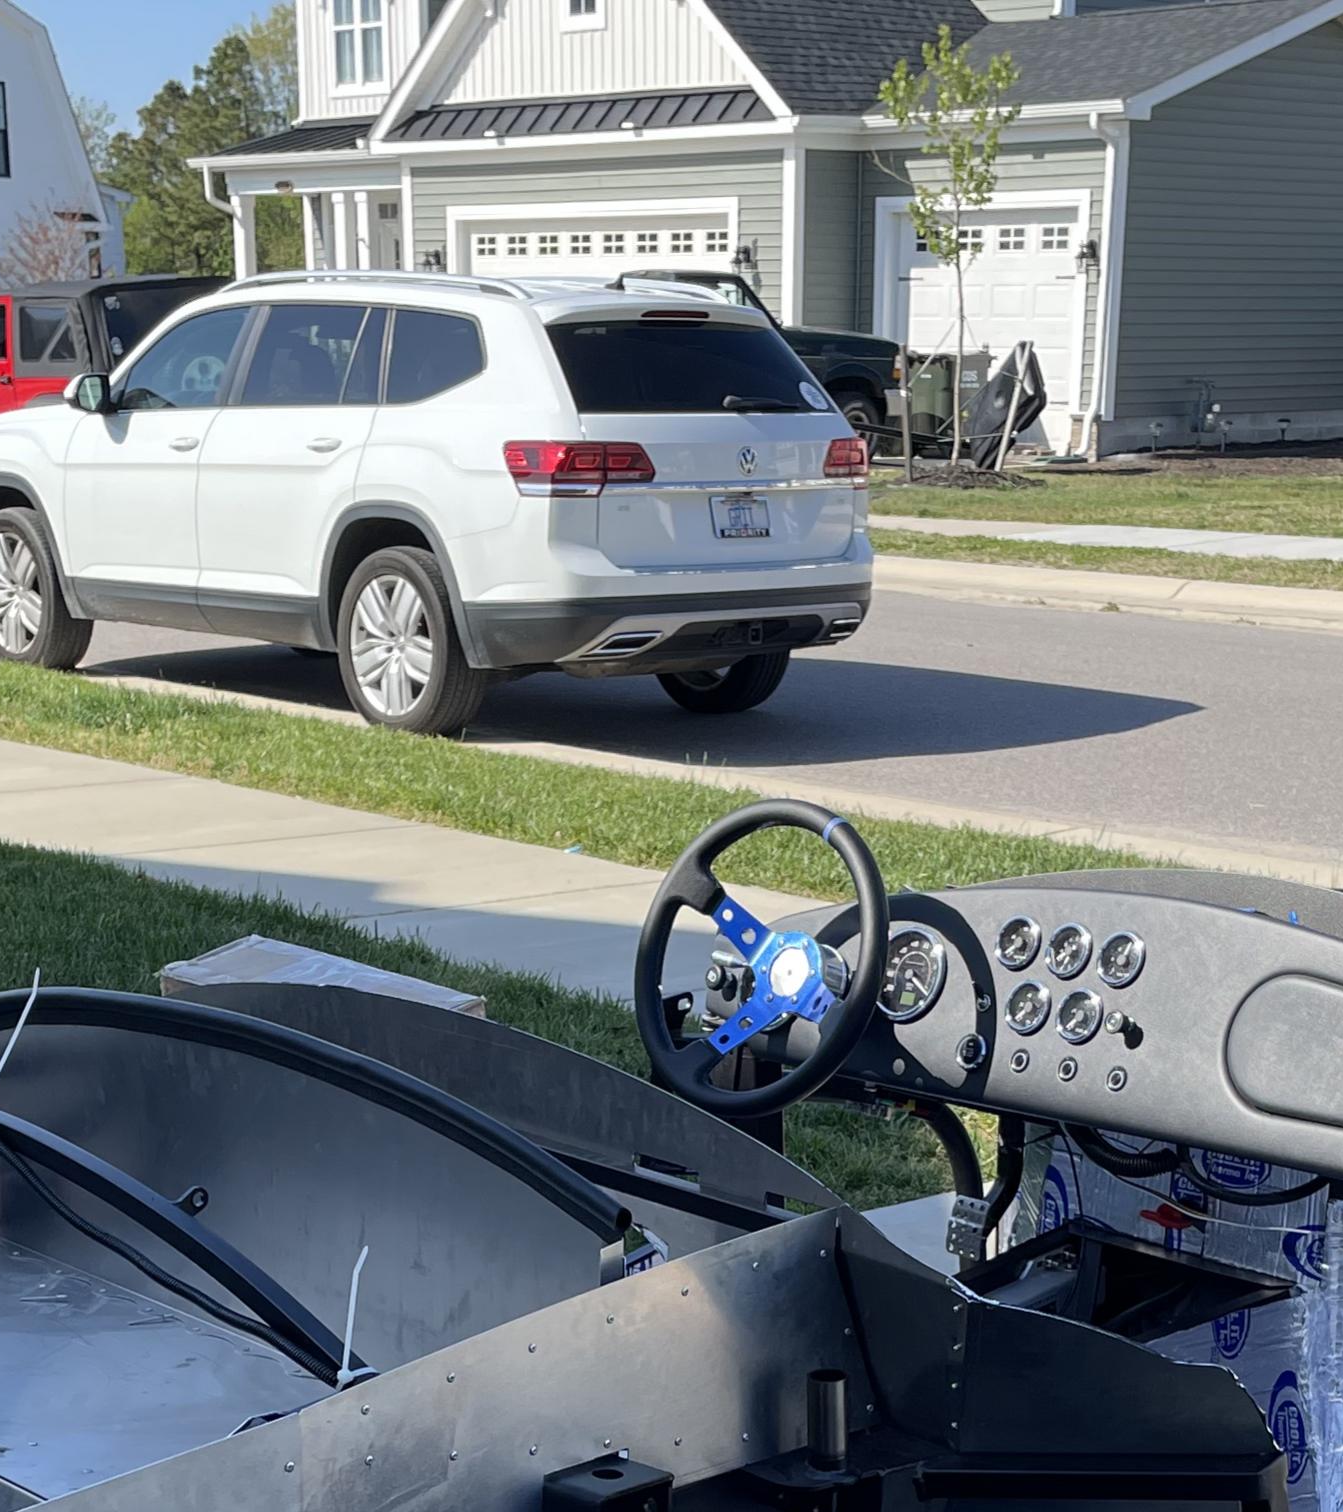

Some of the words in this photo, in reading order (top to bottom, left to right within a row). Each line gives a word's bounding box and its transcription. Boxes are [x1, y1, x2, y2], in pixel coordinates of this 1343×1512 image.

[724, 528, 768, 537] PRIORITY
[1288, 1406, 1300, 1449] COOL
[1292, 1451, 1302, 1465] IT
